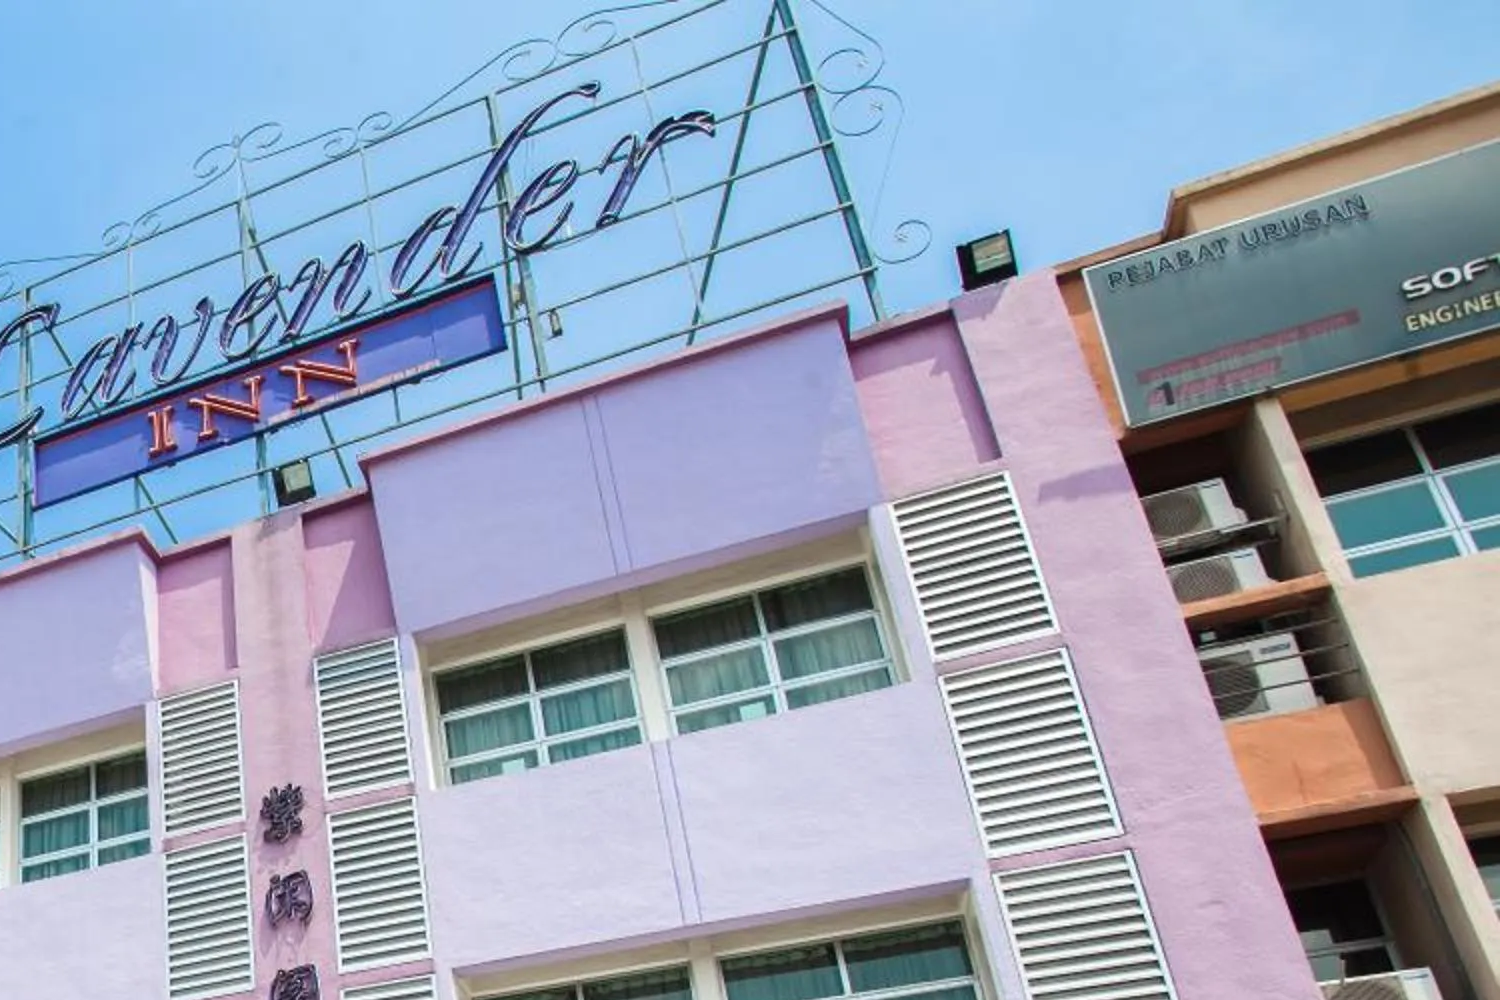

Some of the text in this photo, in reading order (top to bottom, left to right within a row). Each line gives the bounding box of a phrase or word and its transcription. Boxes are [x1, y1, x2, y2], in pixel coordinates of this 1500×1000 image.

[1107, 195, 1372, 291] PEJABAT URUSAN
[147, 338, 363, 458] INN
